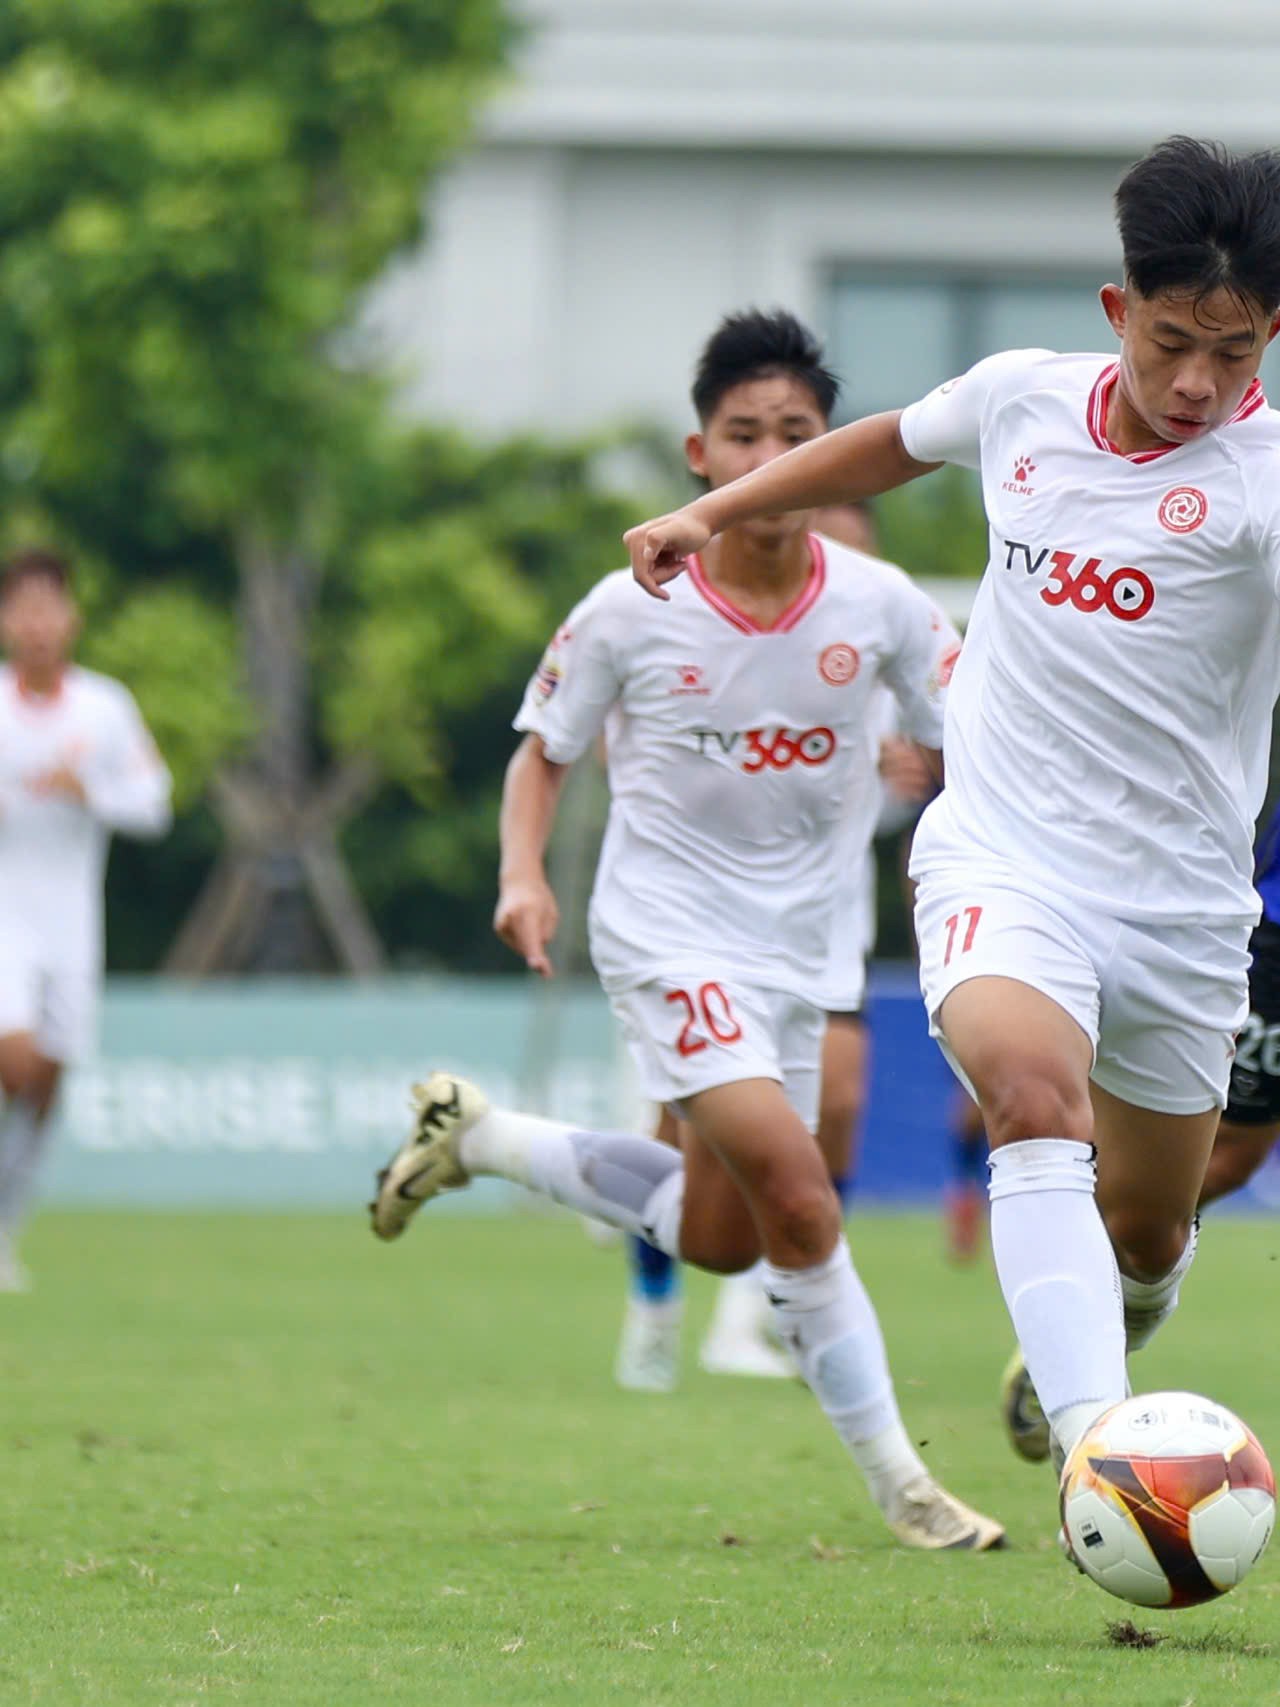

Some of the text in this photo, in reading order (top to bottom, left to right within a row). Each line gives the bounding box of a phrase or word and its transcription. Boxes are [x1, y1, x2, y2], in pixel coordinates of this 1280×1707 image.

[1002, 482, 1035, 496] KELME
[1004, 540, 1155, 622] TV360
[692, 726, 836, 775] TV360
[944, 906, 983, 968] 11
[664, 982, 742, 1057] 20
